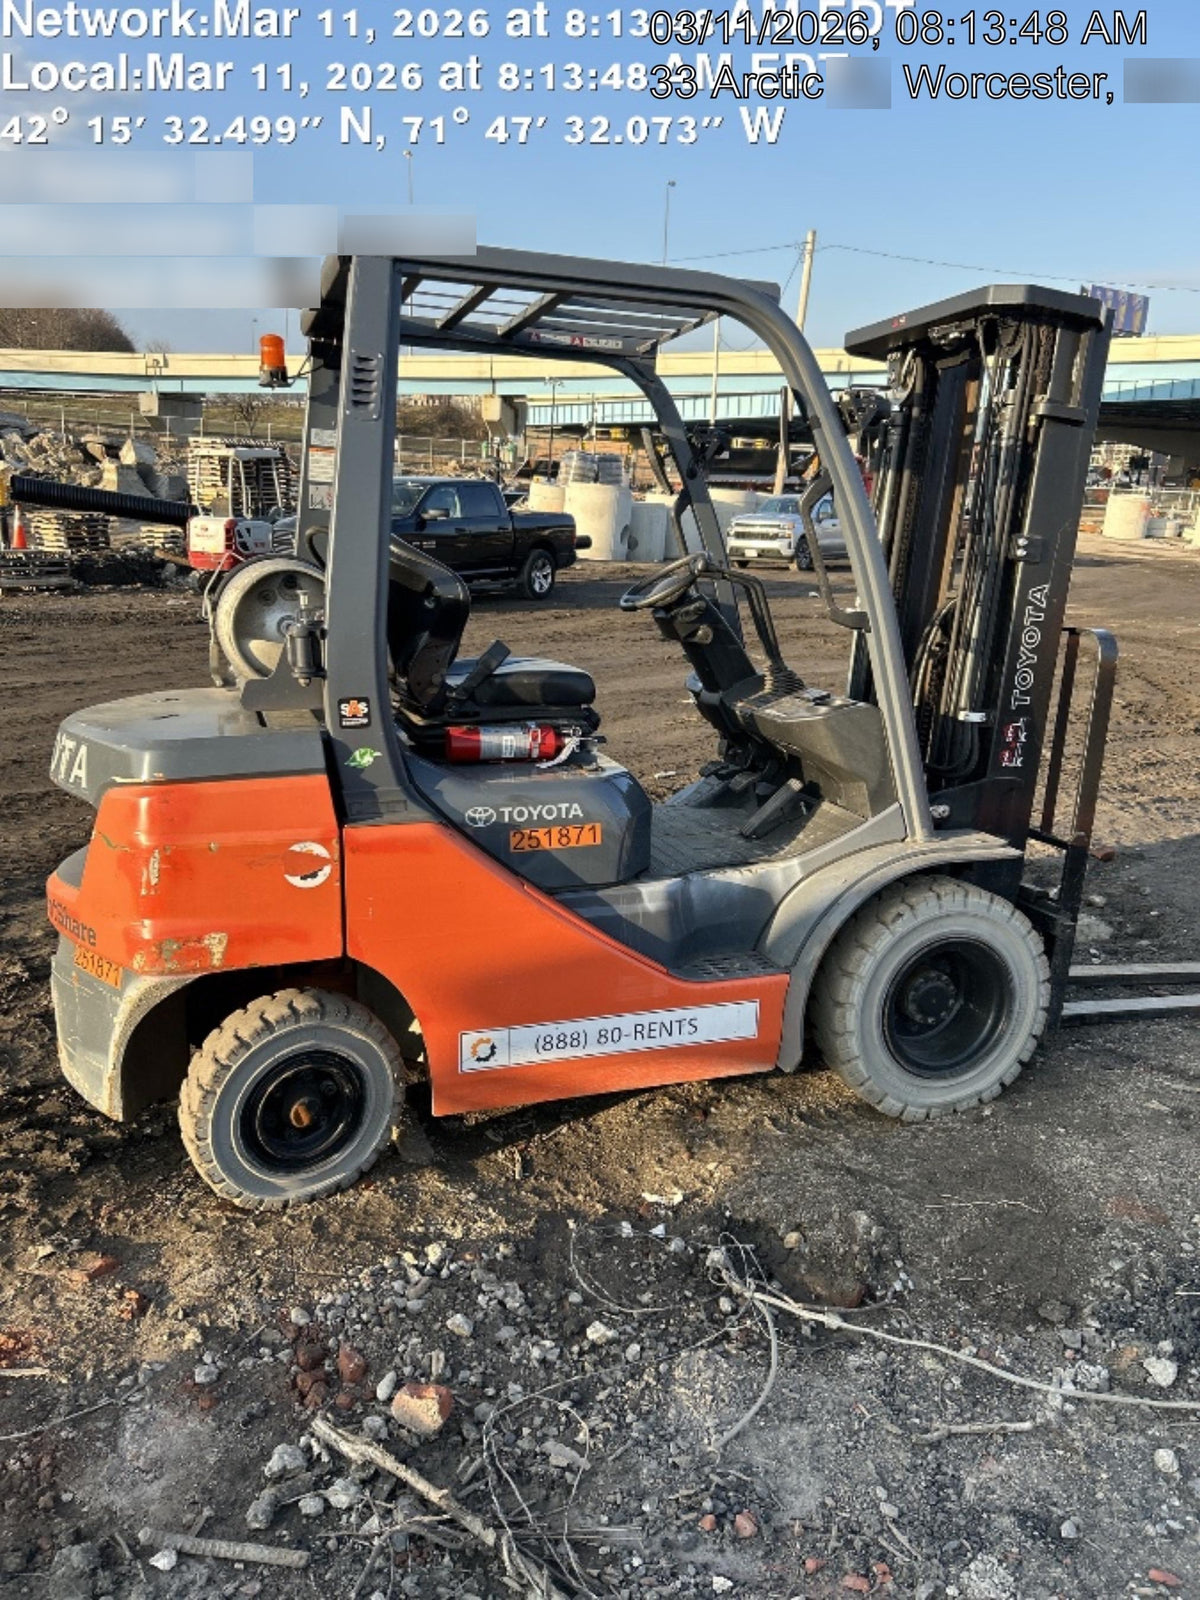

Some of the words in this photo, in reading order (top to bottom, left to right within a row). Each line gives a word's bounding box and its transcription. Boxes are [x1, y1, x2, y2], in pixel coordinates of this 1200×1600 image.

[1010, 583, 1051, 711] TOYOTA
[499, 803, 584, 823] TOYOTA
[511, 824, 598, 851] 251871
[74, 943, 120, 988] 251871
[535, 1032, 588, 1054] (888)
[597, 1018, 699, 1045] 80-RENTS
